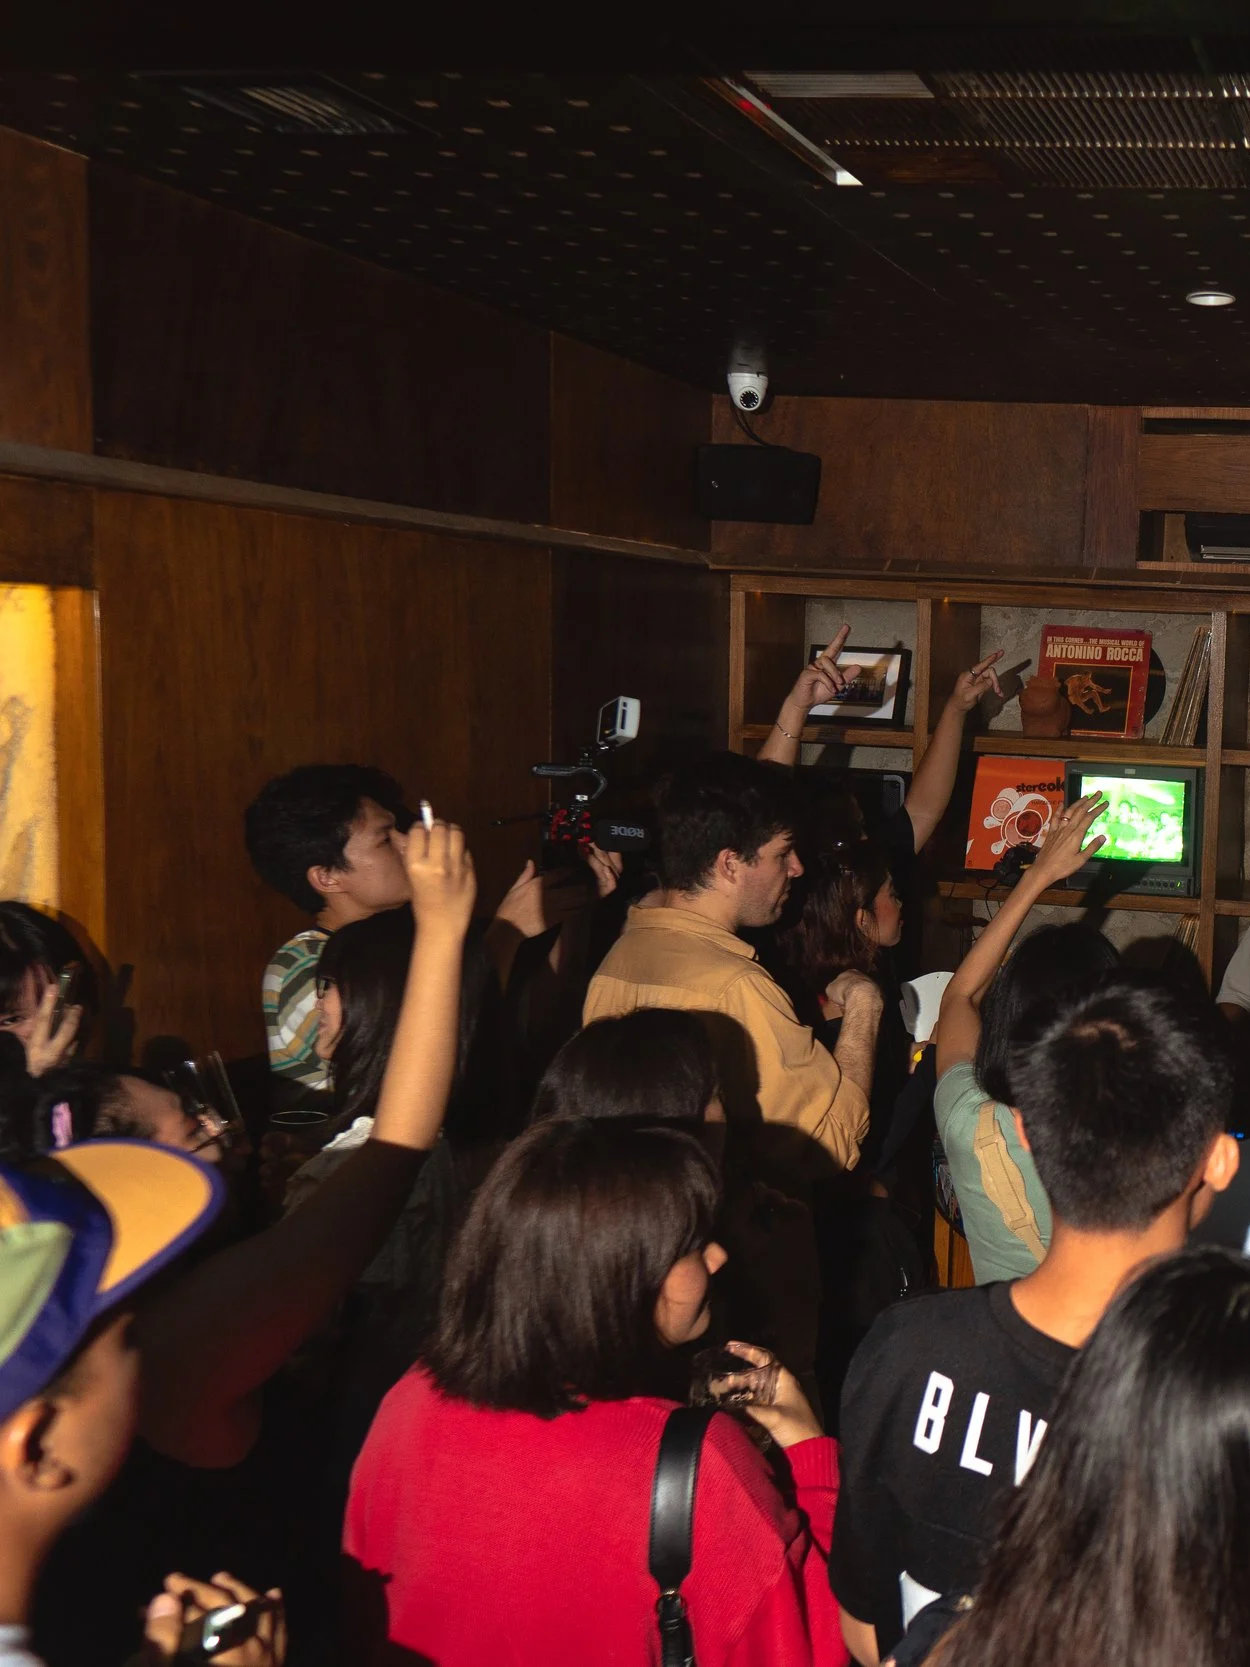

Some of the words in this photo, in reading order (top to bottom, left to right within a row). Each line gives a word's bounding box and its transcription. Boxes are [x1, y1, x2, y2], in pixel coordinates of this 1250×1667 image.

[1045, 644, 1102, 660] ANTONINO
[1106, 647, 1144, 662] ROCCA
[913, 1370, 1048, 1488] BLV
